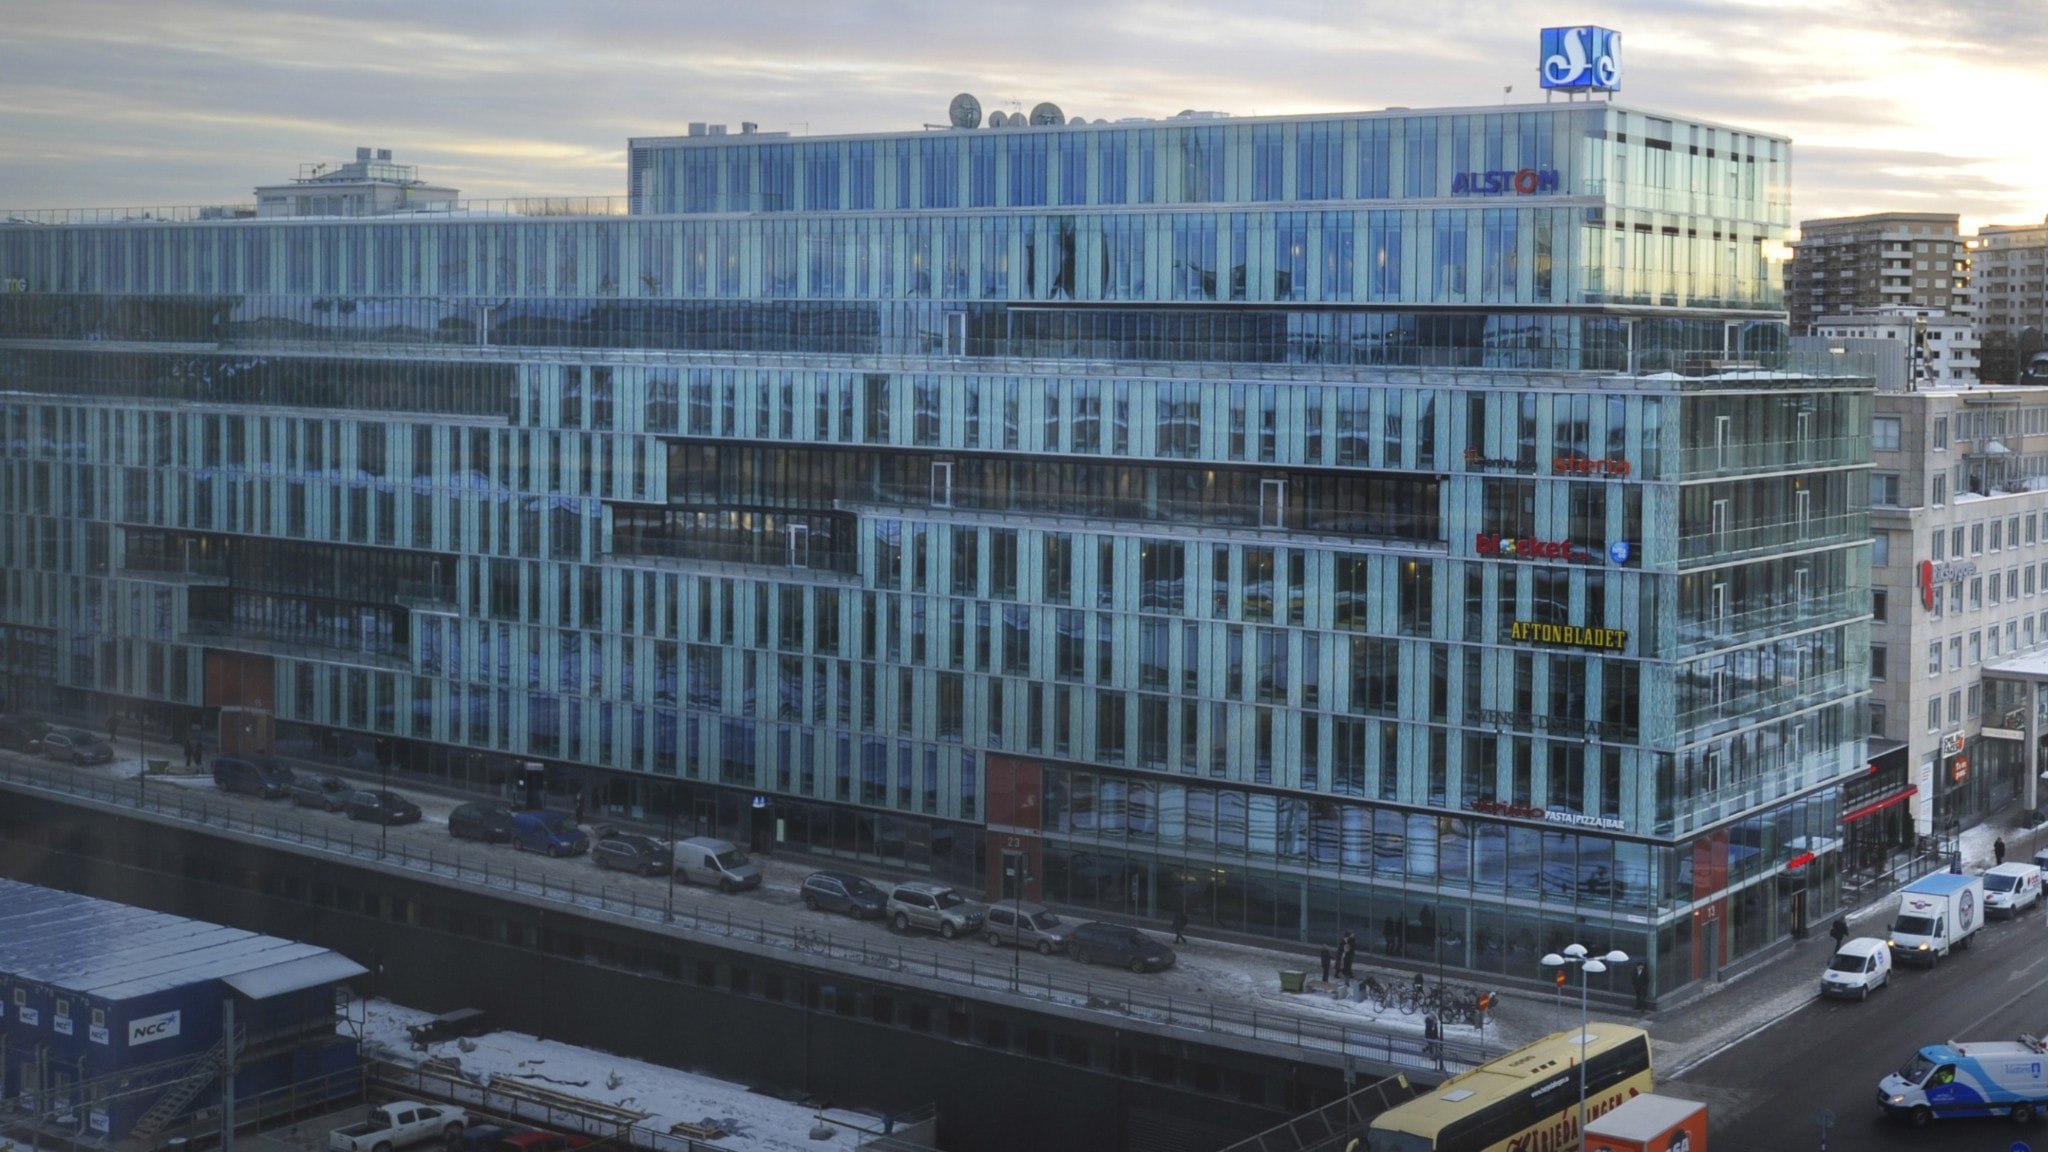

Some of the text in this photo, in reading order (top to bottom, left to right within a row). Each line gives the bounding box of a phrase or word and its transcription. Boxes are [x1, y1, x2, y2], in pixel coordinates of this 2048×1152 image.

[1452, 168, 1558, 194] ALSTOM
[1511, 621, 1626, 648] AFTONBLADET
[1008, 837, 1020, 848] 23
[134, 1022, 167, 1039] NCC
